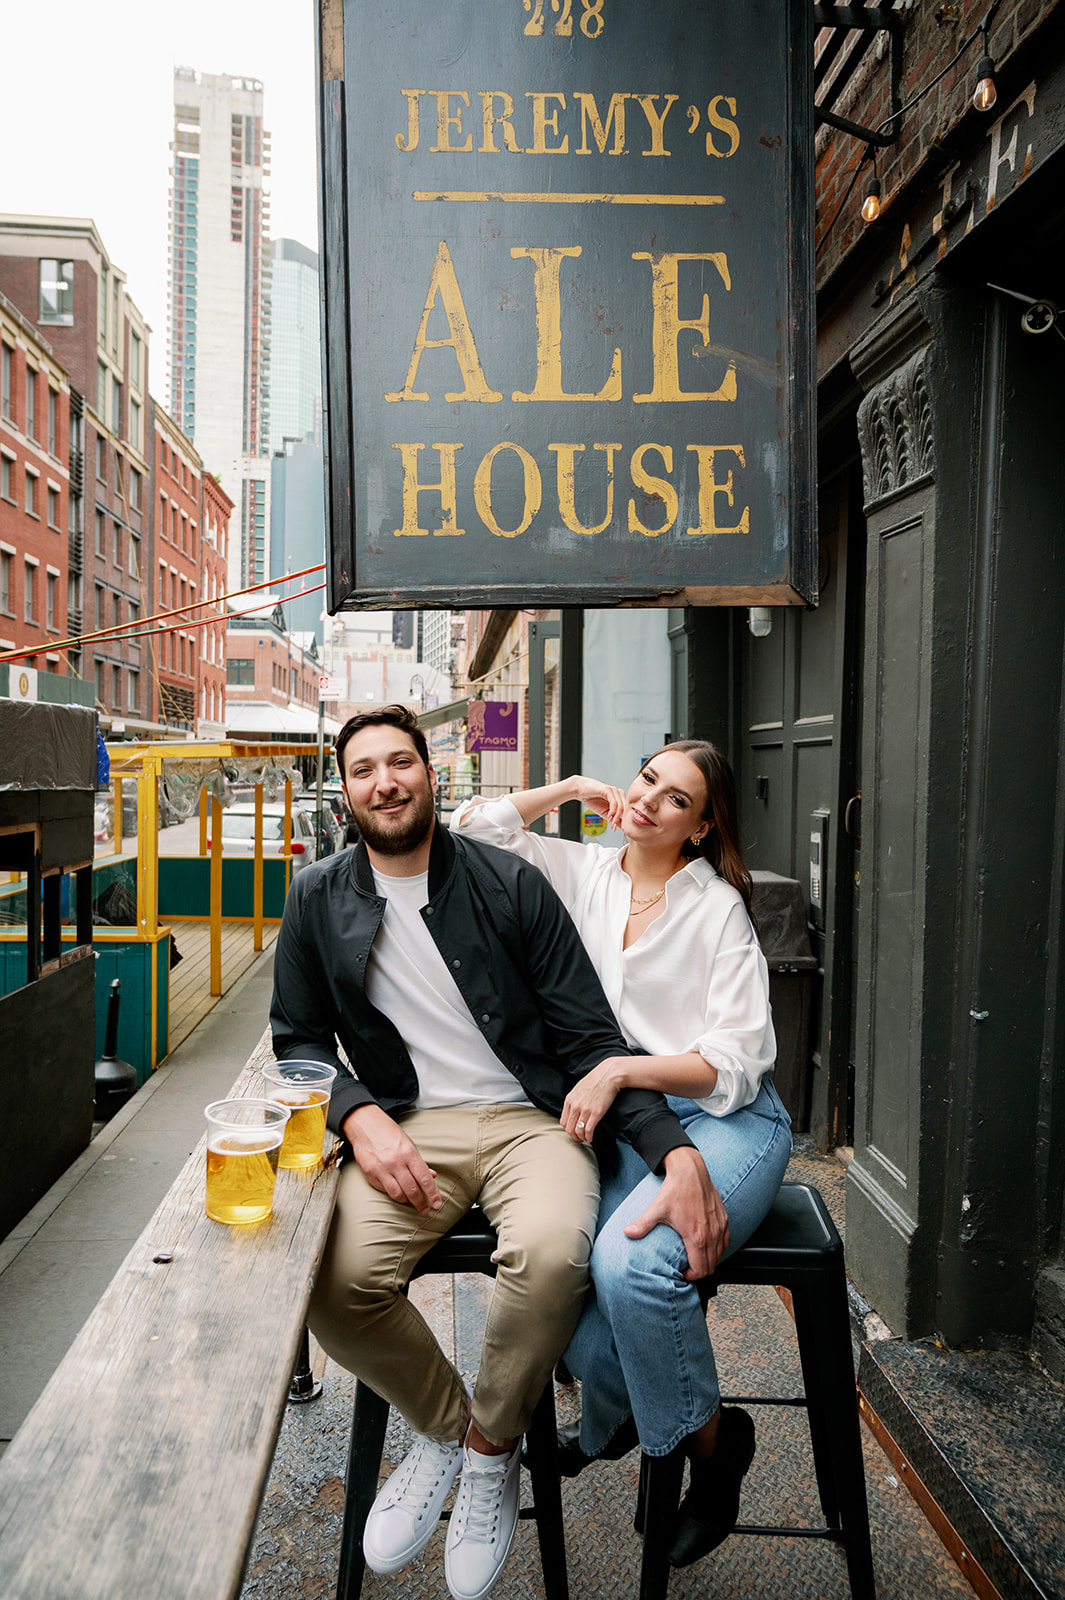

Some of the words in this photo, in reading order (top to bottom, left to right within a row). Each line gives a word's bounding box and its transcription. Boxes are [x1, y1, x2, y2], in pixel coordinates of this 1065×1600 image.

[523, 0, 605, 39] 228
[394, 89, 741, 158] JEREMY'S
[384, 240, 738, 403] ALE
[391, 441, 750, 538] HOUSE
[479, 736, 517, 747] TAGMO
